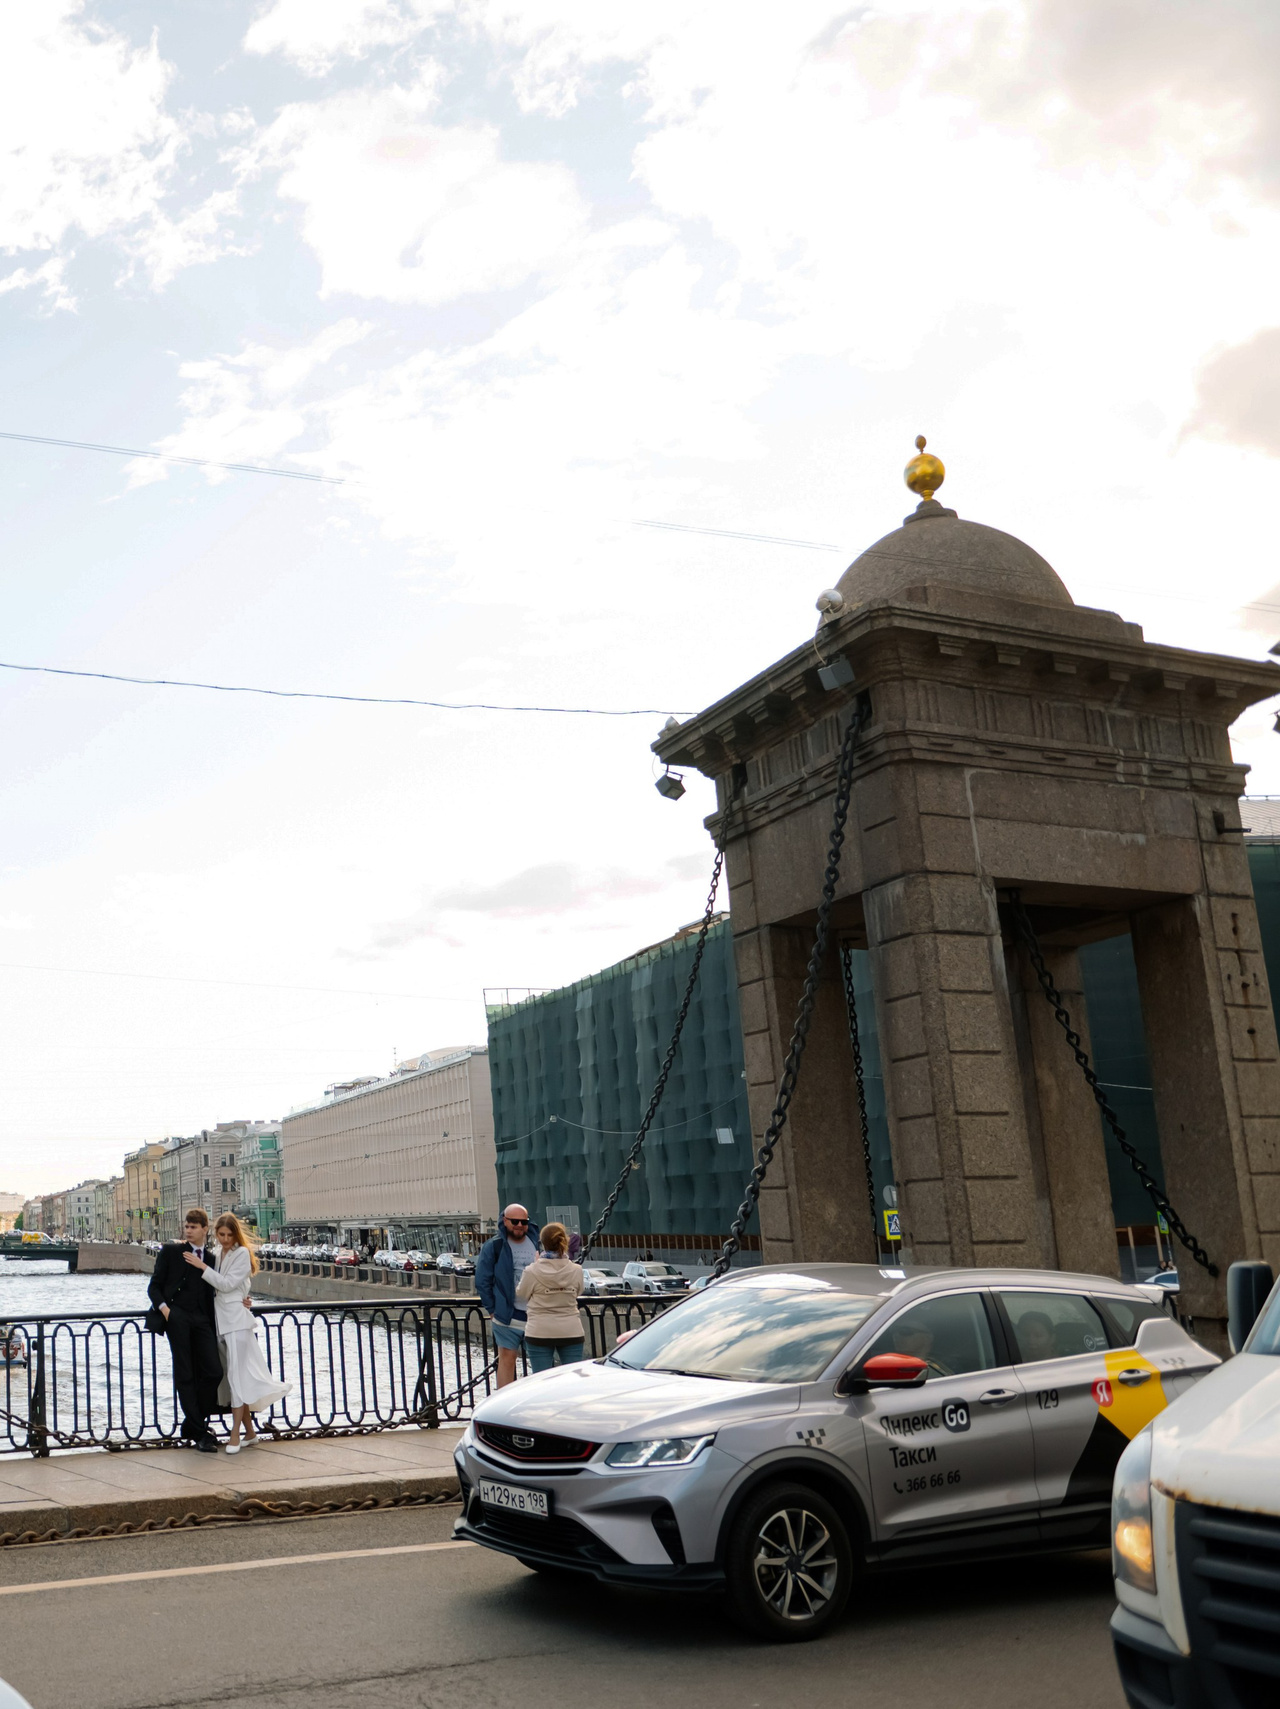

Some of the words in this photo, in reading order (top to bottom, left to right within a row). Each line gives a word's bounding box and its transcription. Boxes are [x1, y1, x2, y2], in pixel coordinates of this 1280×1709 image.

[1035, 1388, 1059, 1410] 129
[1096, 1382, 1109, 1403] Я
[880, 1413, 939, 1437] Яндекс
[945, 1405, 967, 1426] Go
[889, 1446, 937, 1468] Такси
[906, 1476, 927, 1492] 366
[930, 1473, 944, 1487] 66
[947, 1470, 961, 1485] 66
[527, 1492, 545, 1508] 198
